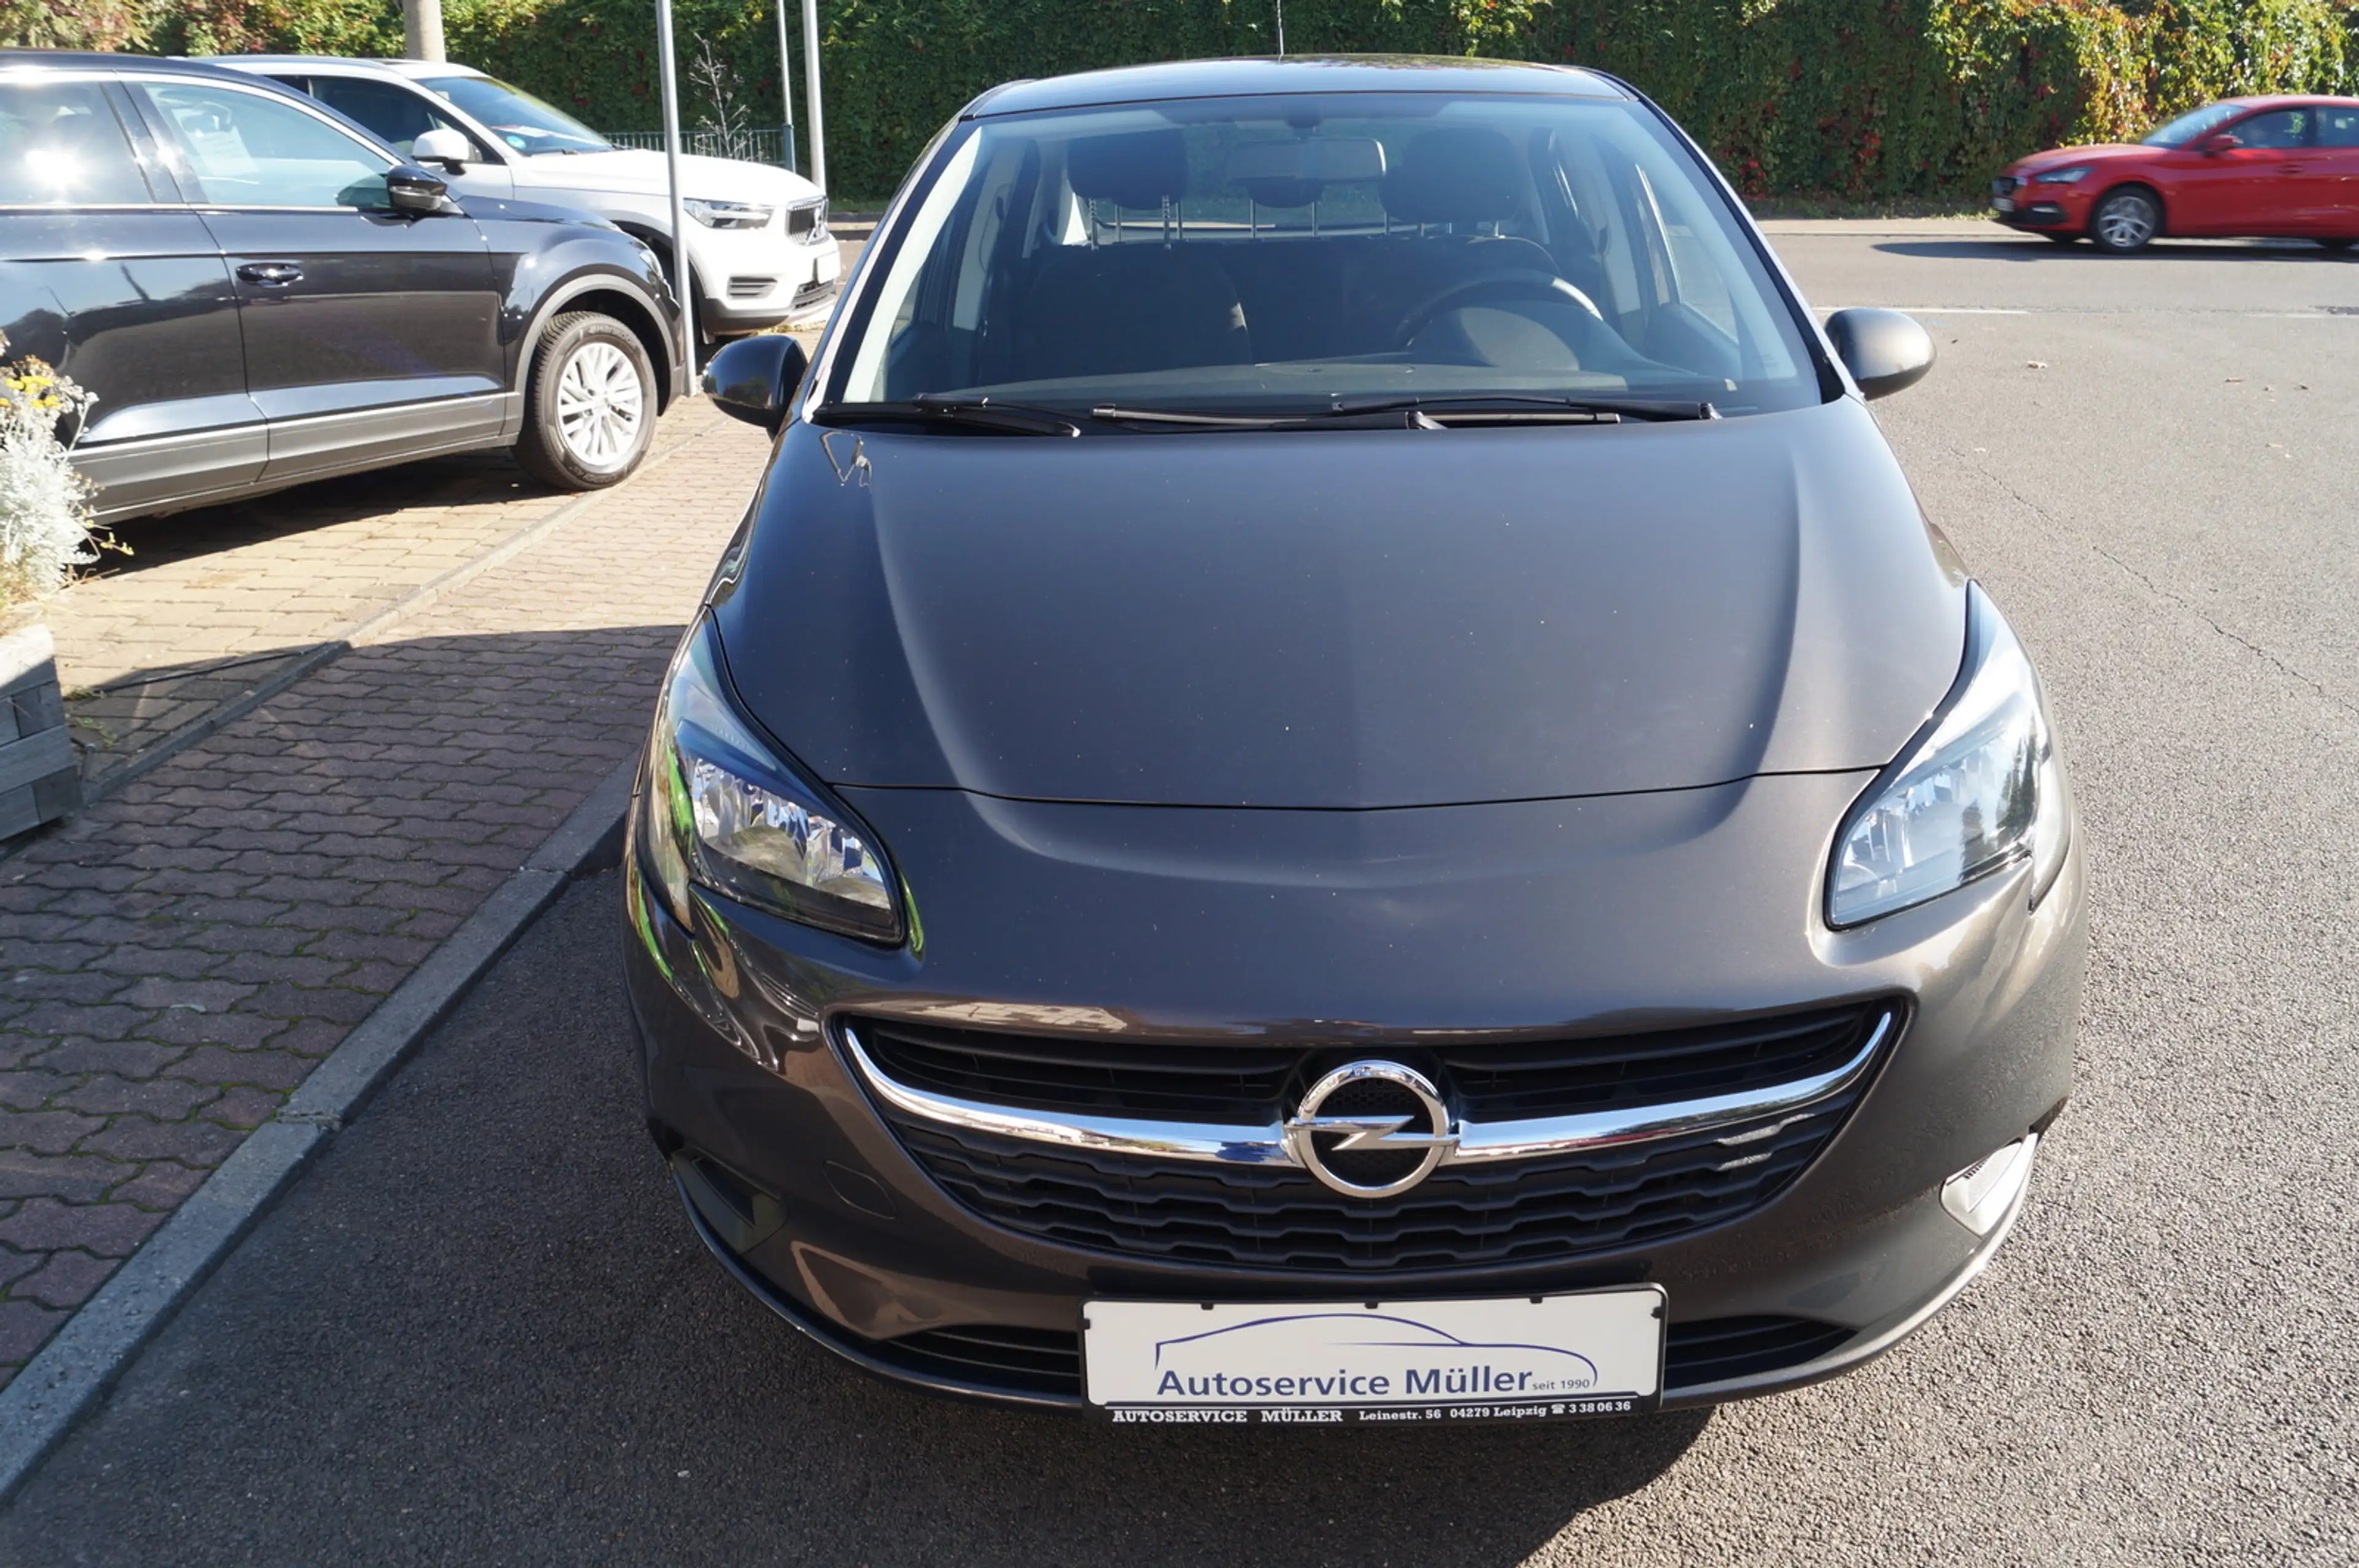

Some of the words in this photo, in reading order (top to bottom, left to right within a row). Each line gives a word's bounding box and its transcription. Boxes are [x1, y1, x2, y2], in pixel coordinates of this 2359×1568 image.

[1157, 1369, 1390, 1397] Autoservice
[1406, 1365, 1533, 1394] Müller
[1532, 1380, 1555, 1391] seit
[1560, 1378, 1590, 1389] 1990
[1112, 1410, 1248, 1423] AUTOSERVICE
[1261, 1407, 1344, 1422] MÜLLER
[1359, 1410, 1422, 1421] Leinestr.
[1425, 1409, 1441, 1420] 56
[1450, 1408, 1490, 1419] 04279
[1493, 1405, 1546, 1418] Leipzig
